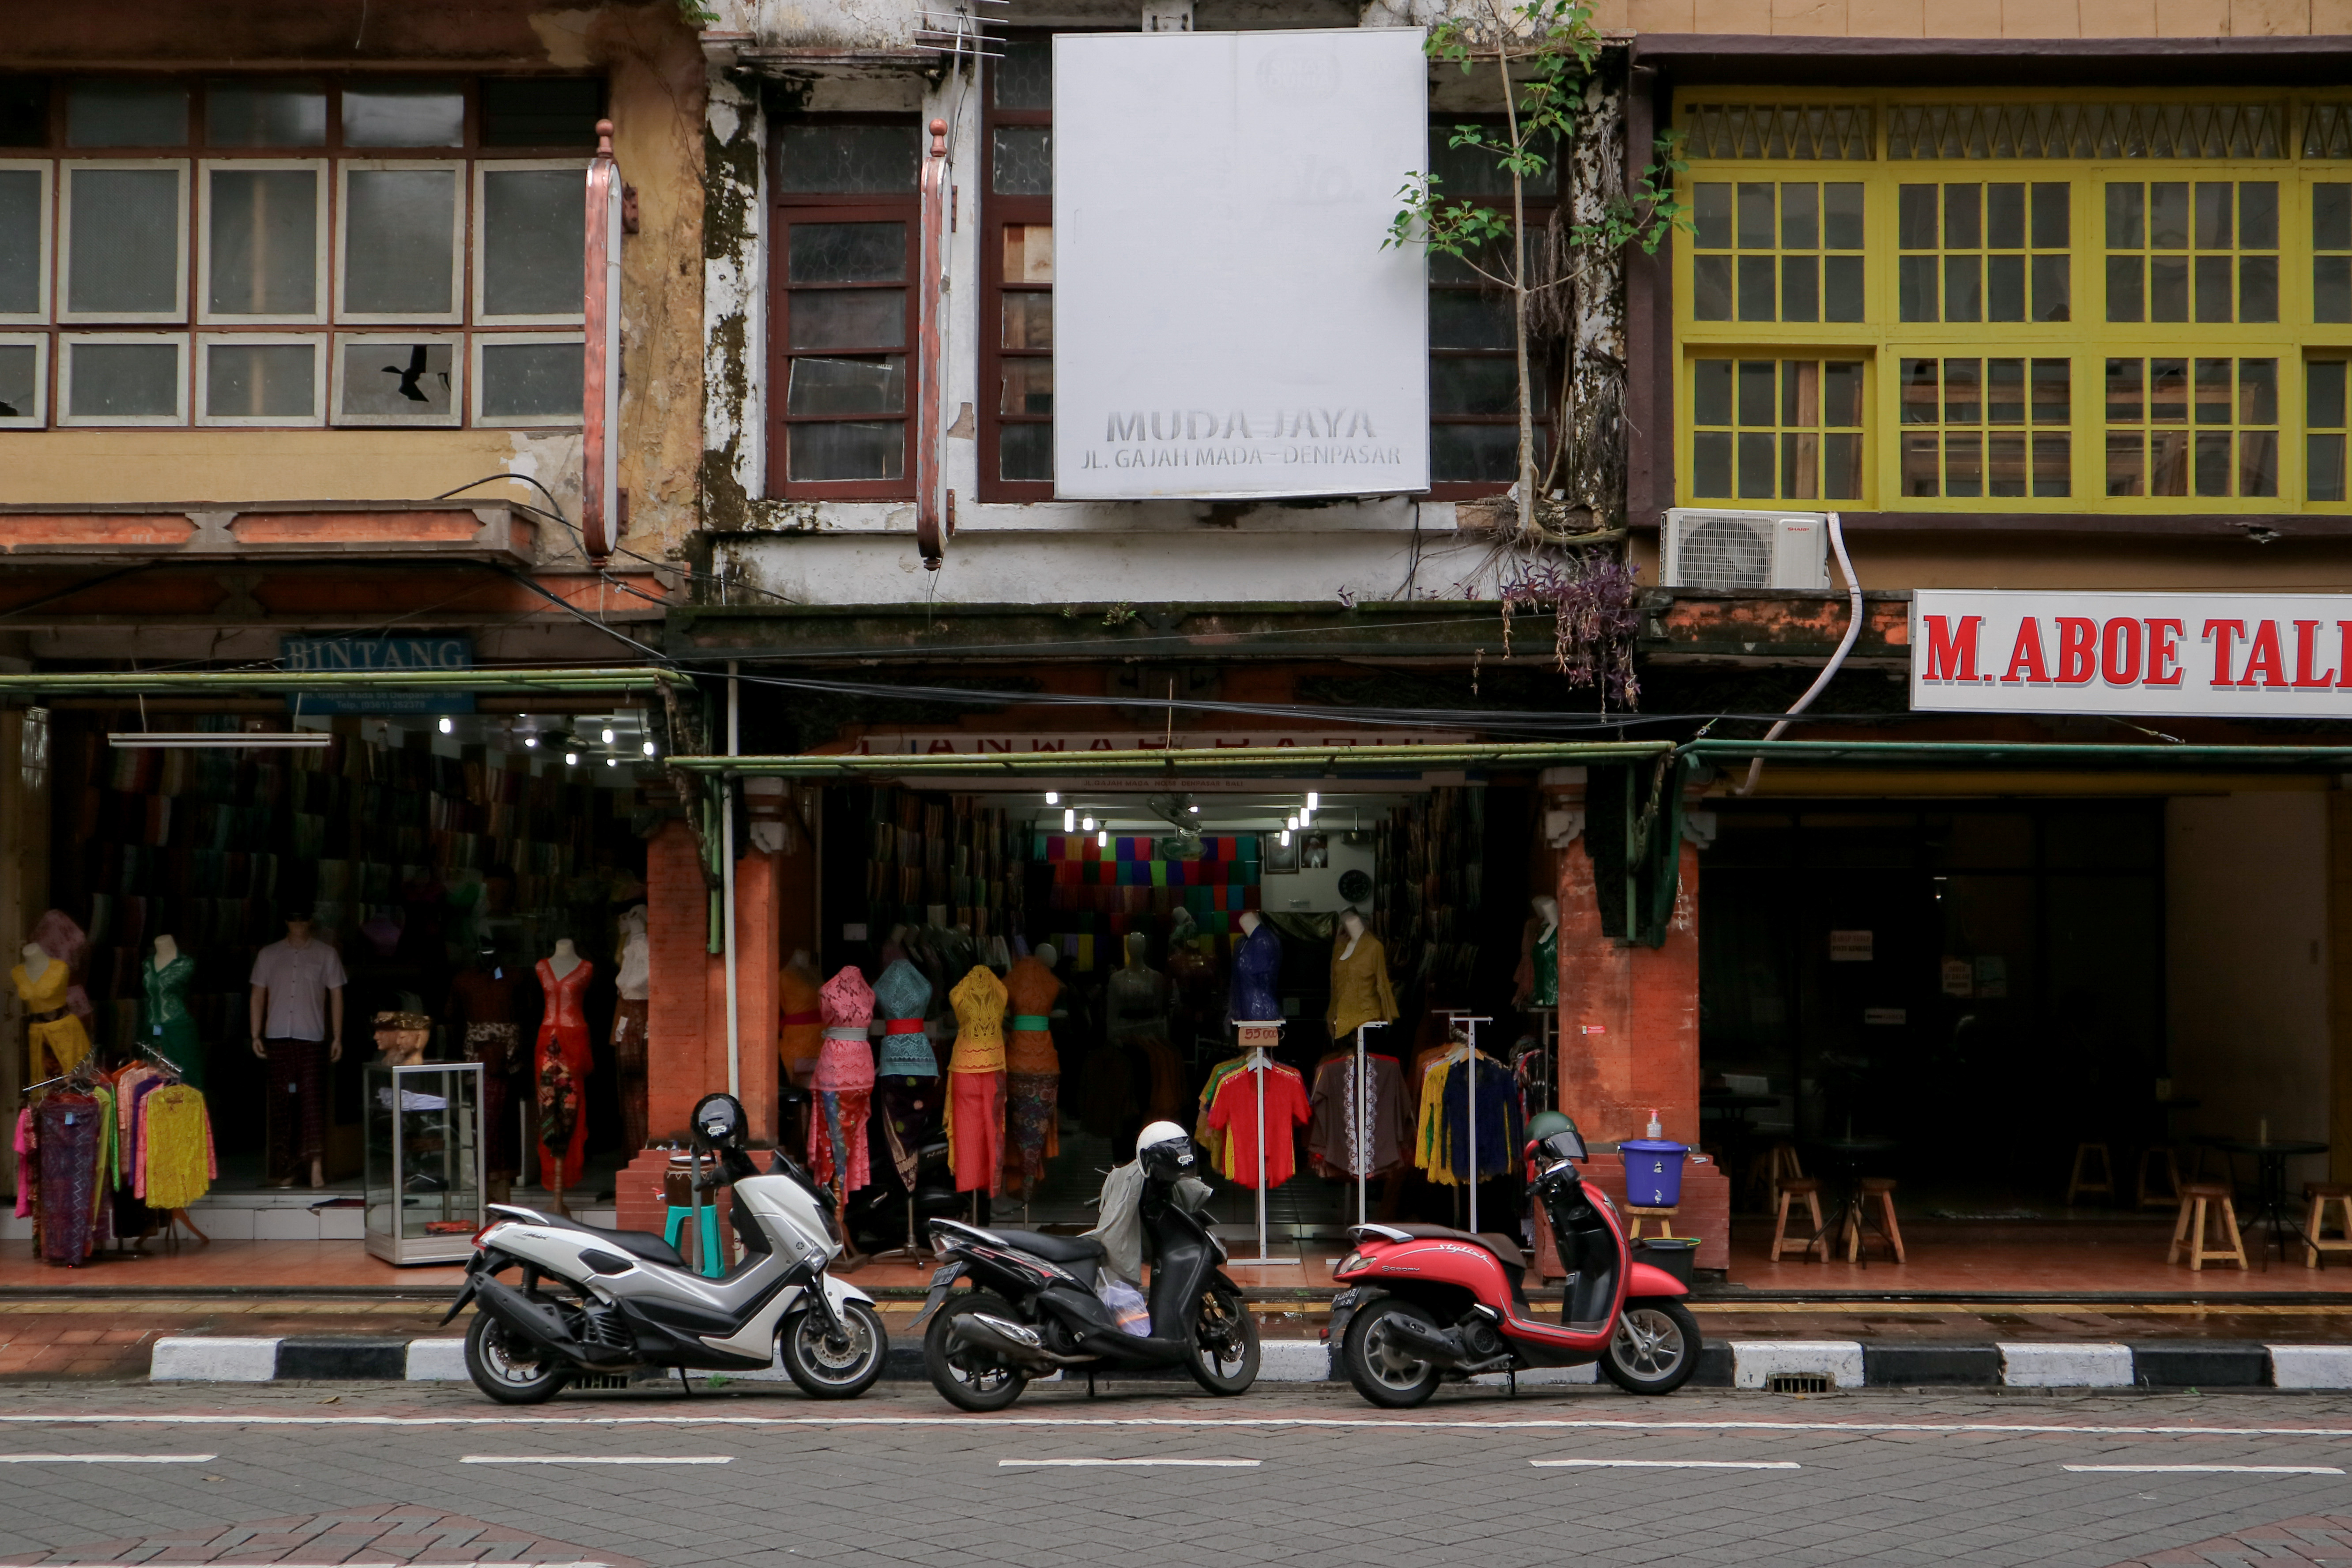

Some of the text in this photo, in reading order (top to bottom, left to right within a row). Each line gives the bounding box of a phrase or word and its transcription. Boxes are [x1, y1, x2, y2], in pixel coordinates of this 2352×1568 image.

[1106, 407, 1377, 441] MUDA JAYA
[1081, 450, 1108, 469] JL.
[1115, 448, 1189, 468] GAJAH
[1196, 446, 1263, 466] MADA
[1283, 445, 1401, 465] DENPASAR
[287, 641, 464, 671] BINTANG
